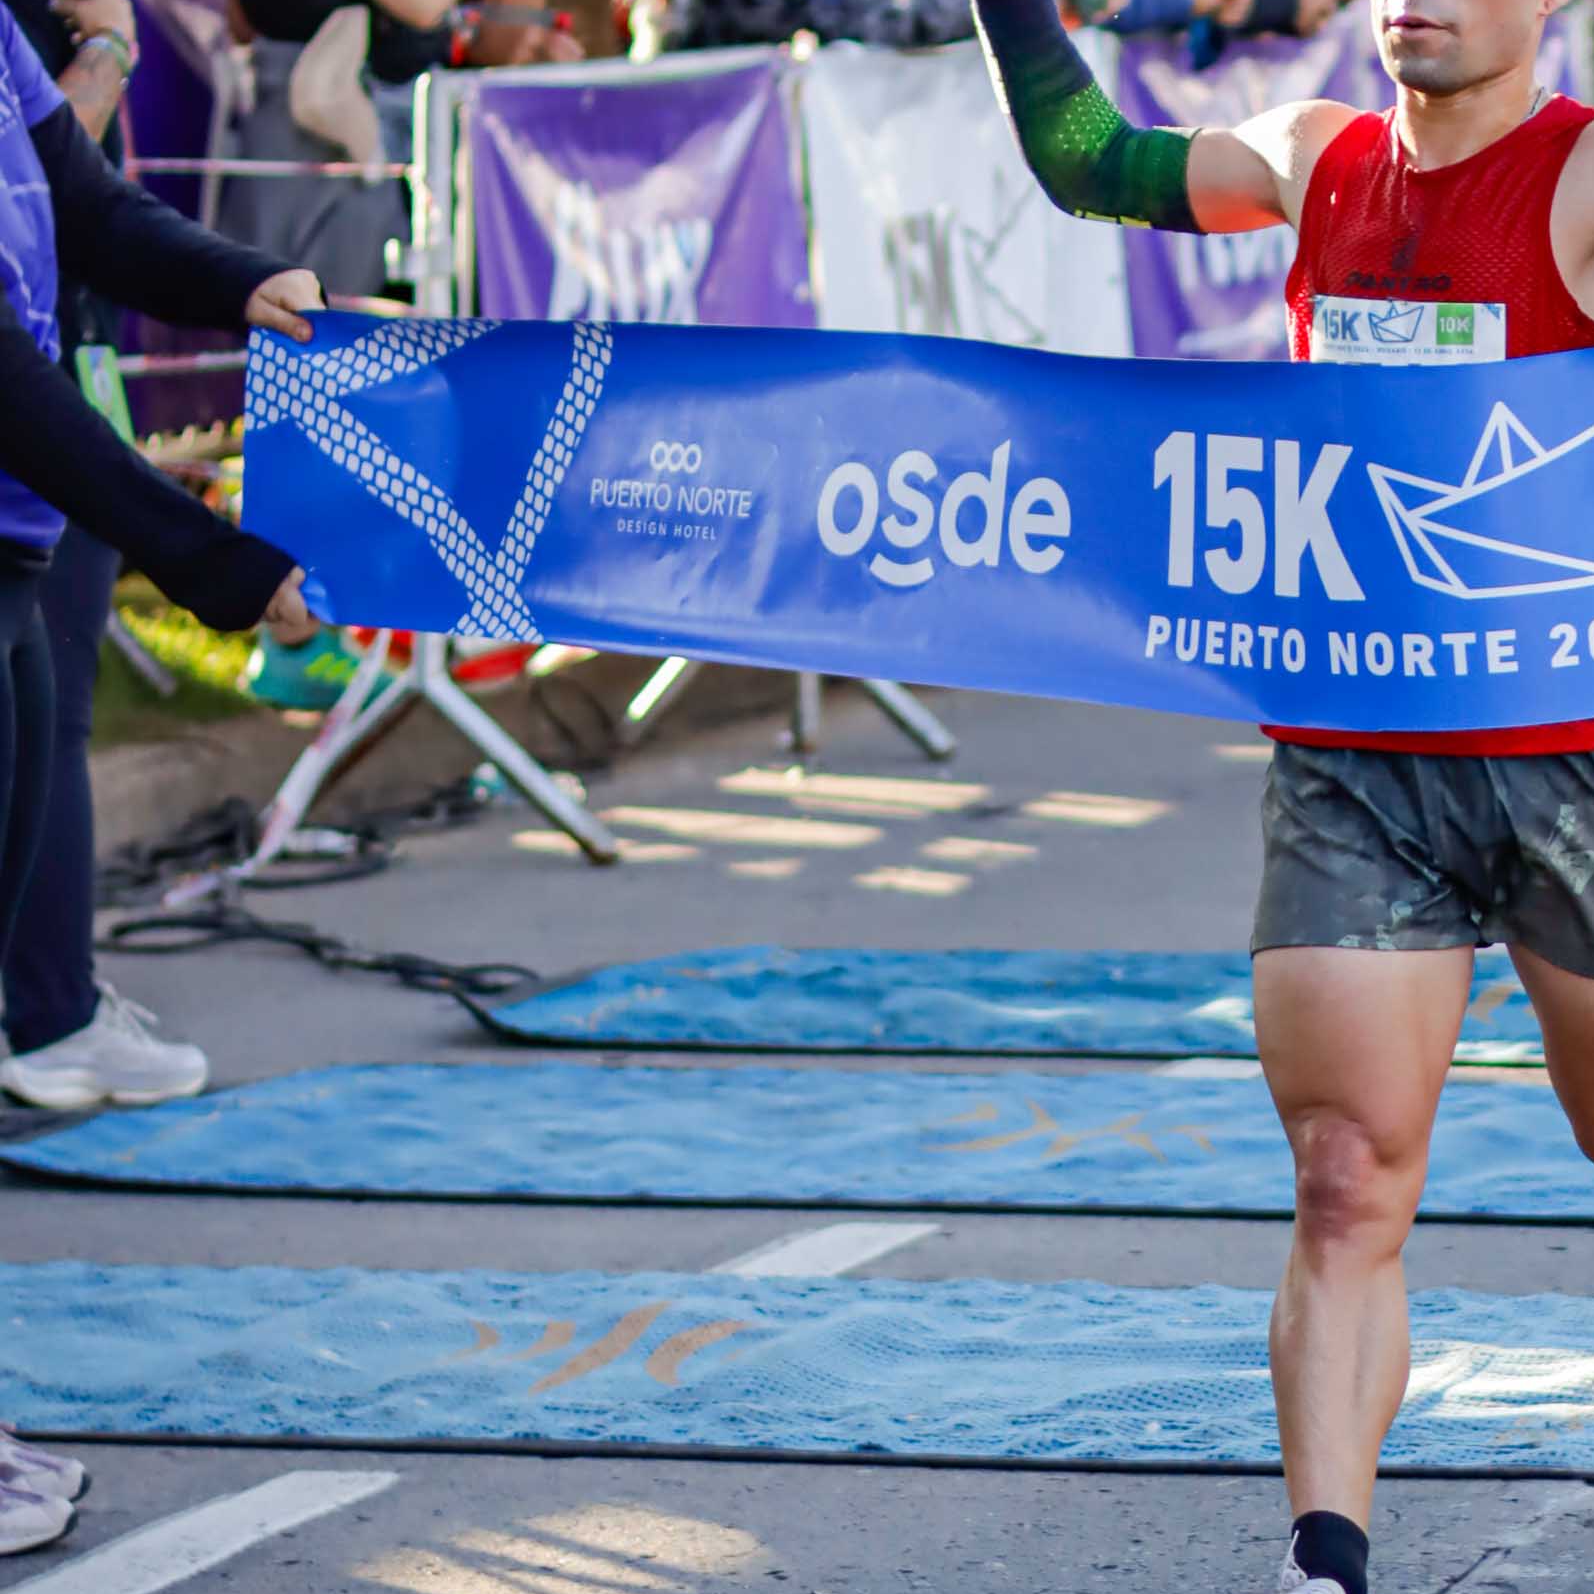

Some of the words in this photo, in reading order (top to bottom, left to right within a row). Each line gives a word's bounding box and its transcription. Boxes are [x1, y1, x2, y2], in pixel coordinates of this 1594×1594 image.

[1321, 308, 1362, 342] 15K
[1439, 316, 1468, 334] 10K
[589, 477, 671, 512] PUERTO
[677, 485, 753, 518] NORTE
[817, 439, 1071, 574] osde
[1153, 431, 1366, 601] 15K
[616, 518, 667, 536] DESIGN
[673, 524, 717, 541] HOTEL
[1144, 614, 1306, 673] PUERTO
[1328, 628, 1519, 677] NORTE
